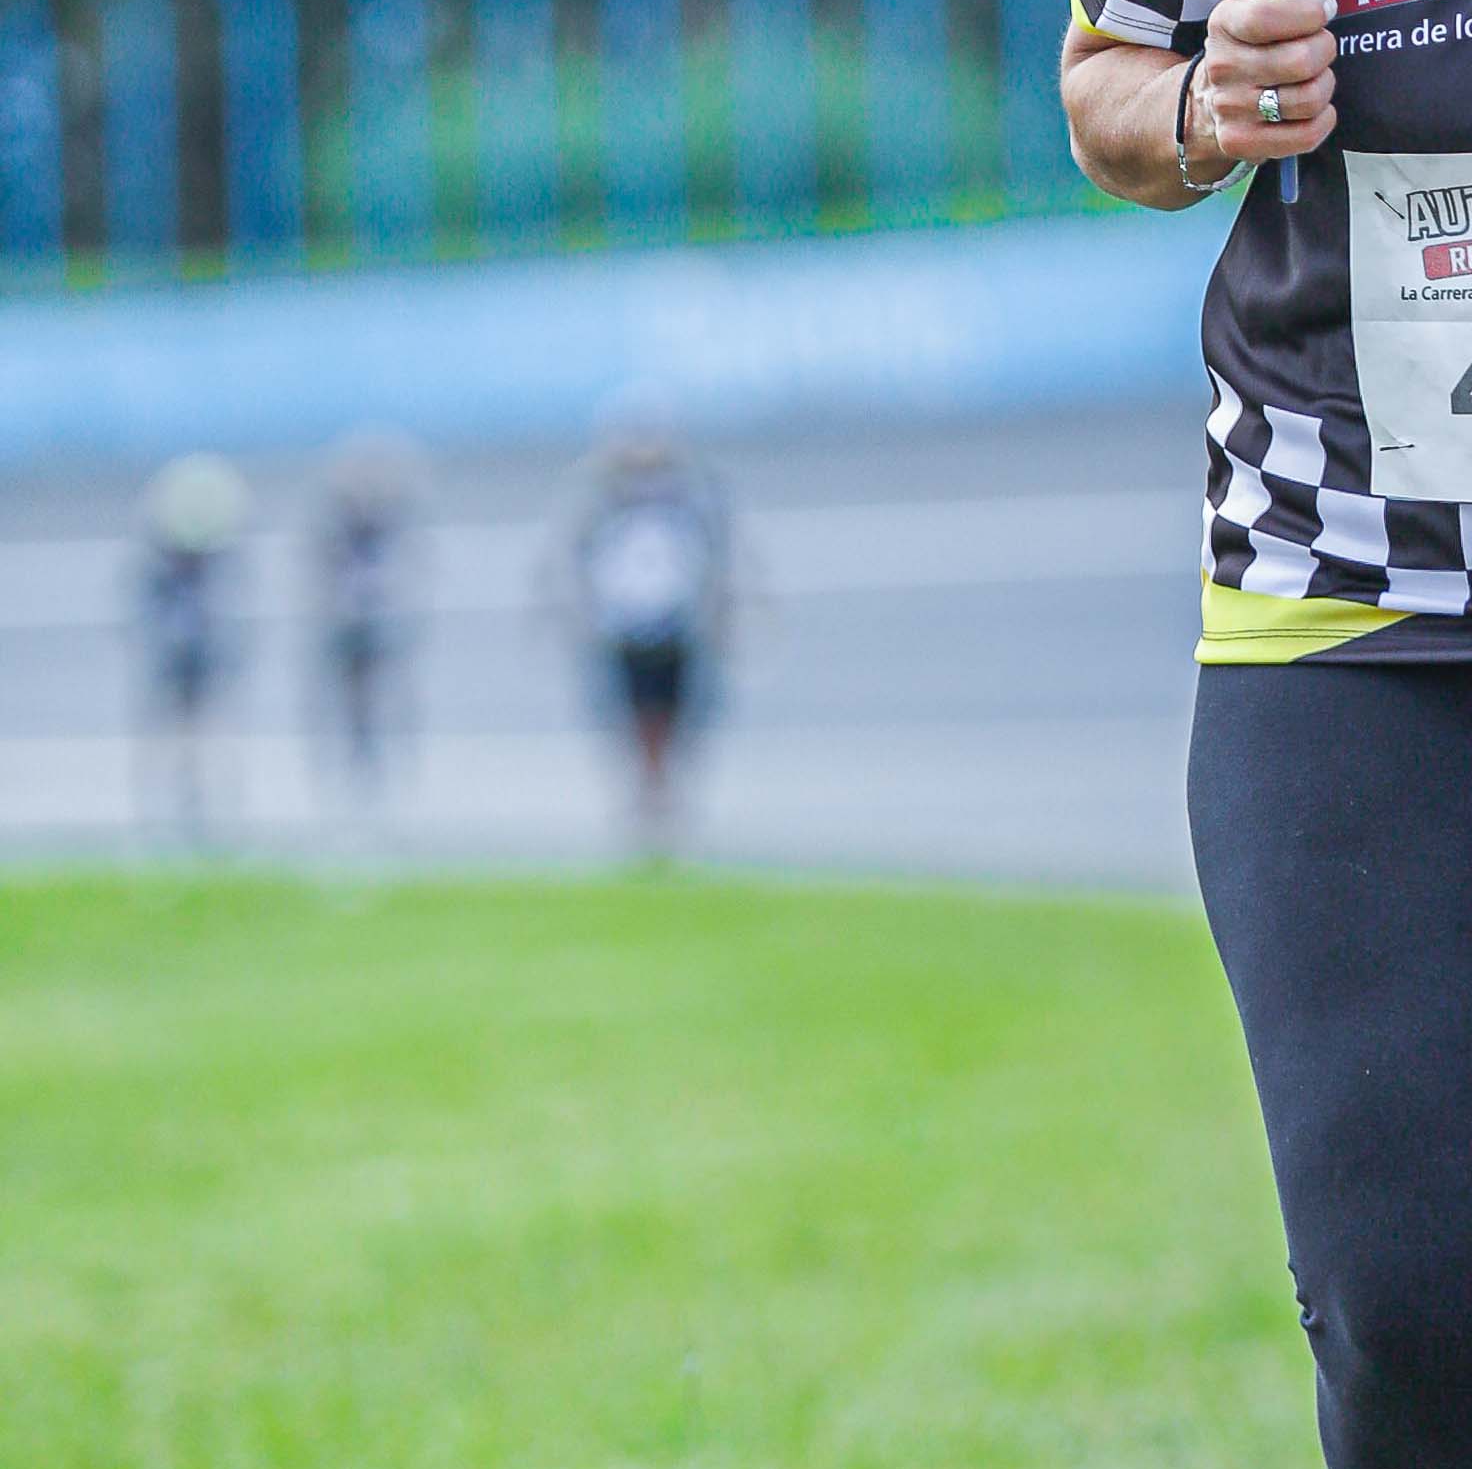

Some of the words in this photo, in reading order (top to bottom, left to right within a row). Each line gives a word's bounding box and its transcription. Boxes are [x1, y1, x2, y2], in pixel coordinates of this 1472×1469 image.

[1338, 28, 1403, 56] rrera
[1411, 18, 1448, 47] de
[1400, 286, 1418, 301] La
